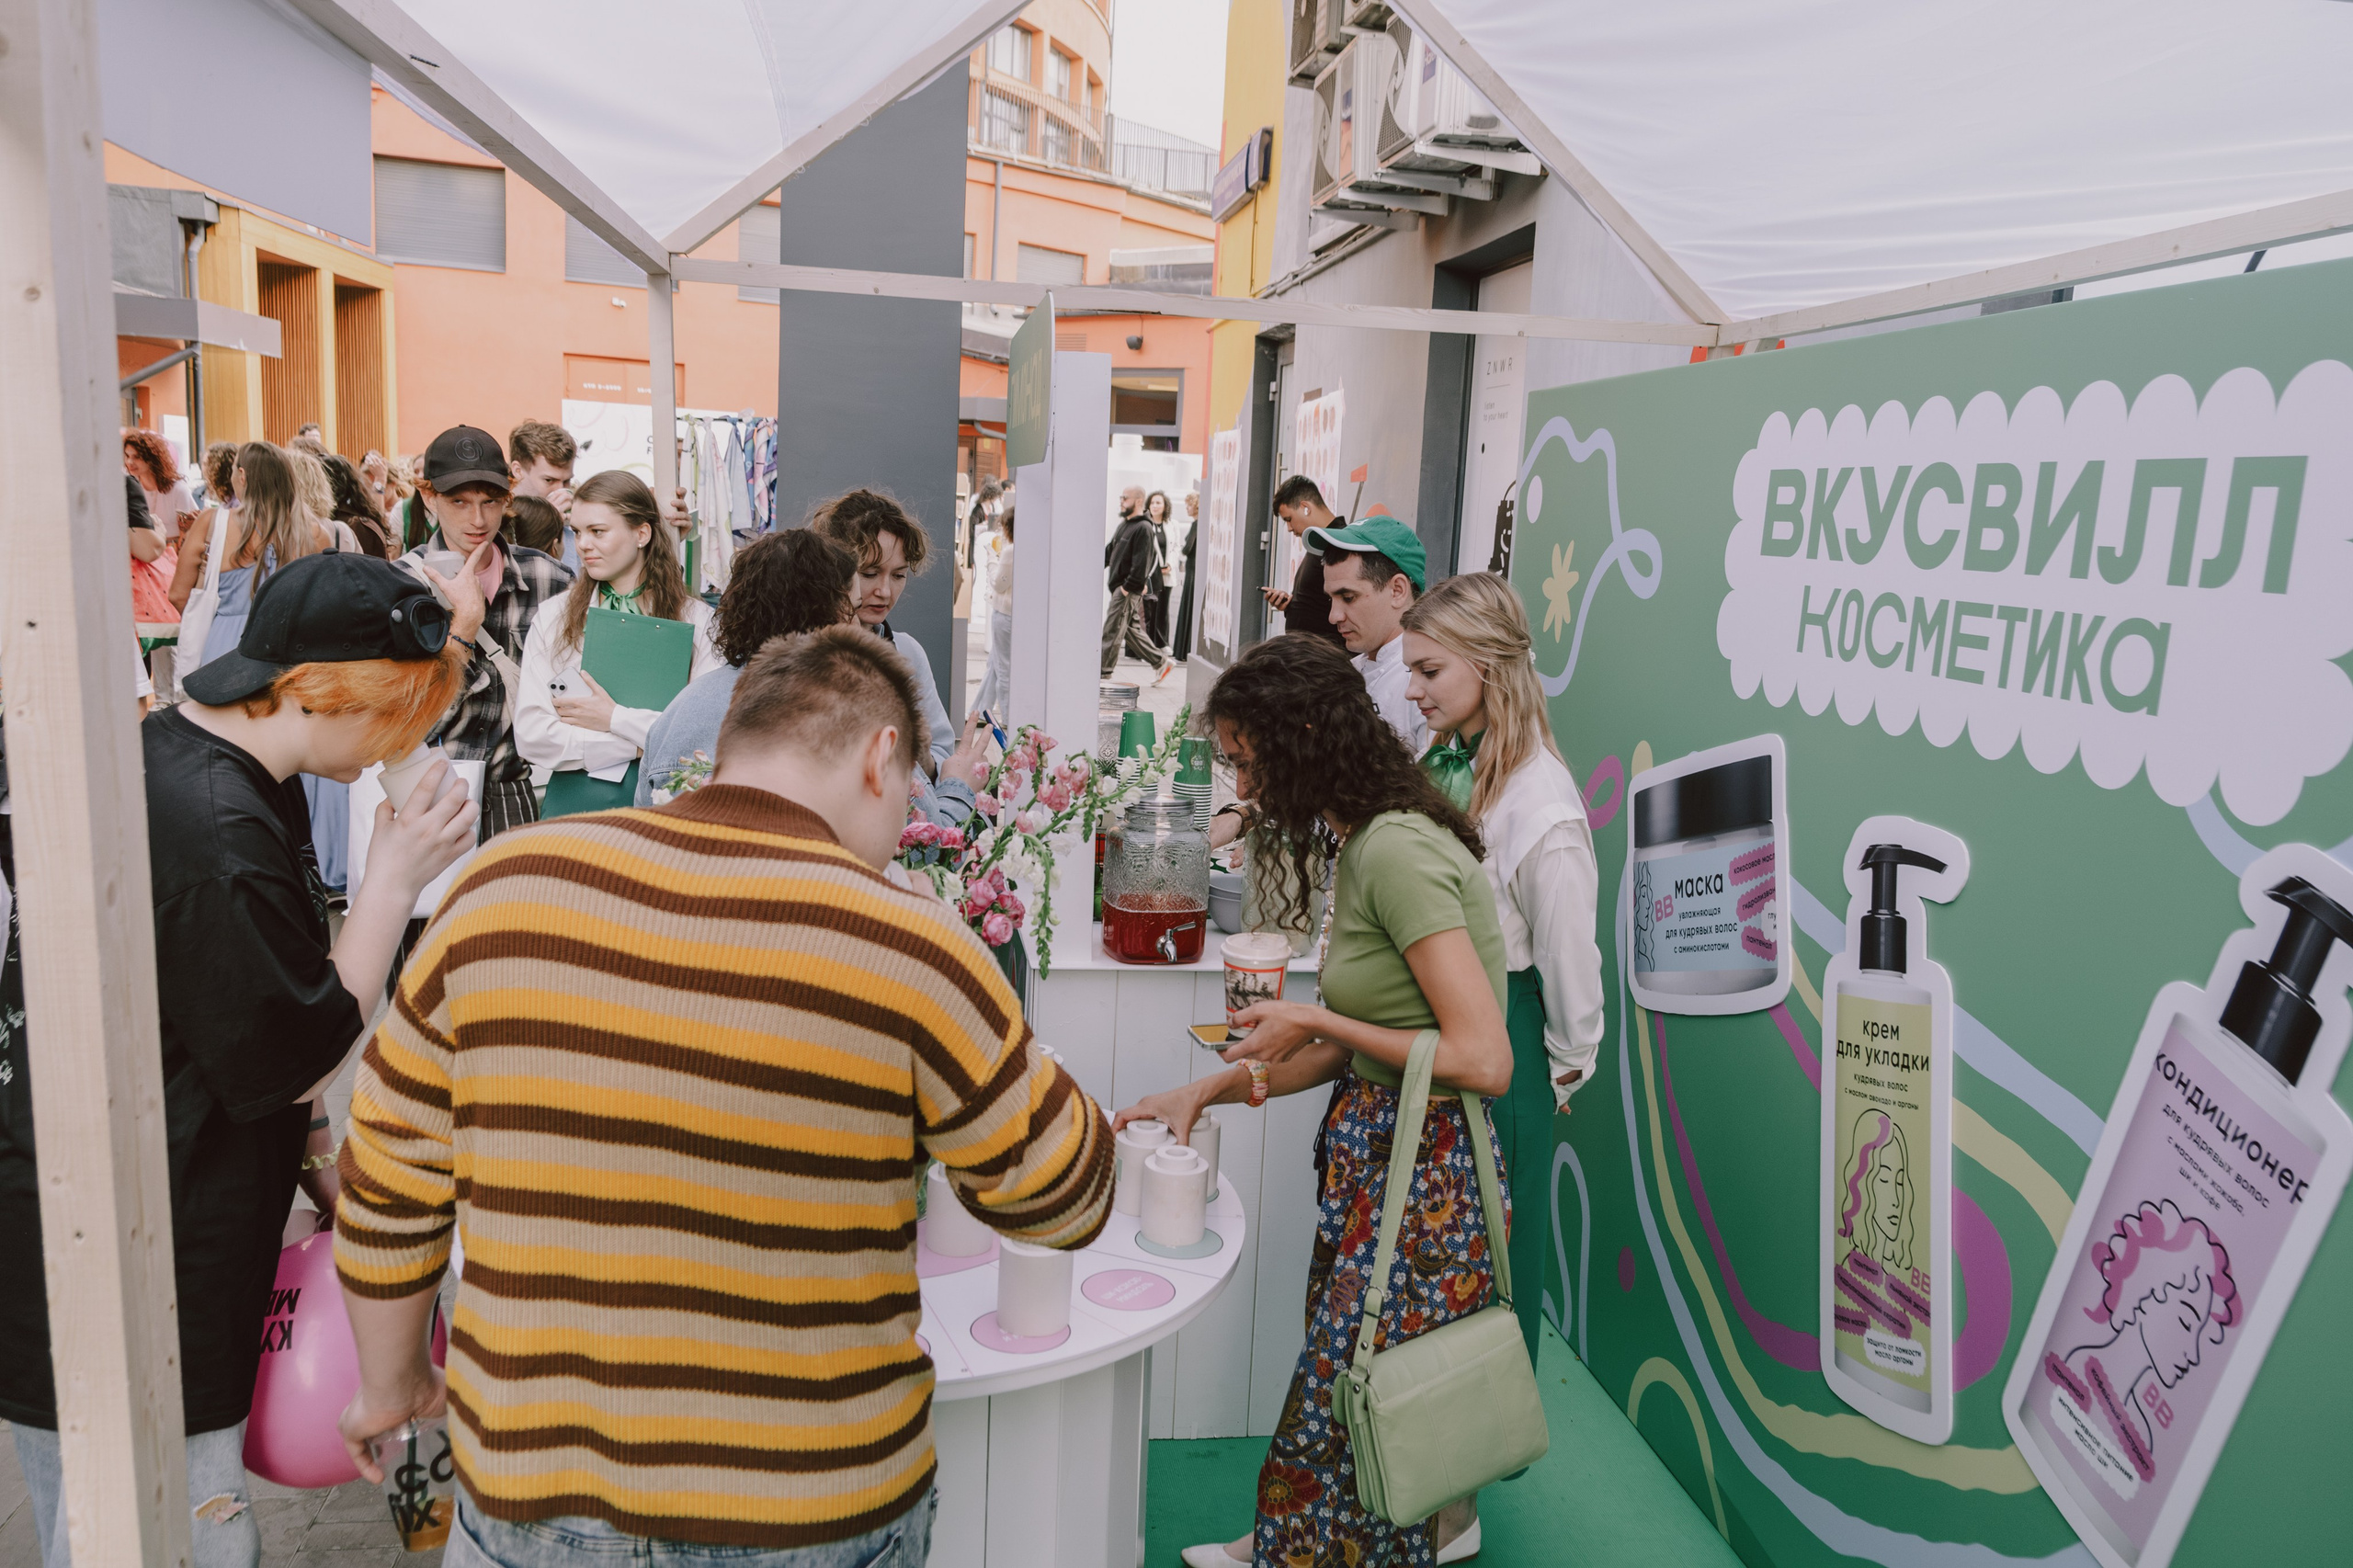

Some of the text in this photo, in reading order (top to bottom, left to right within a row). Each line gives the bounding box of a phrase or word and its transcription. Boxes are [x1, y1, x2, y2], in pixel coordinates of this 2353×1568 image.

[1760, 455, 2308, 595] ВКУСВИЛЛ
[1733, 858, 1761, 874] кокосовое
[1675, 873, 1723, 899] маска
[1678, 906, 1721, 921] увлажняющая
[1665, 922, 1738, 939] для кудрявых волос
[1746, 935, 1772, 949] пантенол
[1678, 942, 1730, 953] аминокислотами
[1862, 1020, 1900, 1042] крем
[1836, 1040, 1929, 1074] для укладки
[1854, 1074, 1909, 1092] кудрявых волос
[1848, 1088, 1868, 1099] маслом
[1869, 1094, 1892, 1106] авокадо
[1898, 1100, 1919, 1110] арганы
[2162, 1103, 2270, 1210] для кудрявых волос
[2174, 1142, 2210, 1179] маслами
[2200, 1186, 2222, 1211] кофе
[1867, 1337, 1922, 1358] защита от ломкости
[1874, 1349, 1892, 1360] масло
[2052, 1363, 2085, 1402] пантенол
[2058, 1396, 2134, 1483] интенсивное питание
[2075, 1429, 2097, 1457] масло
[2120, 1423, 2150, 1471] экстракт
